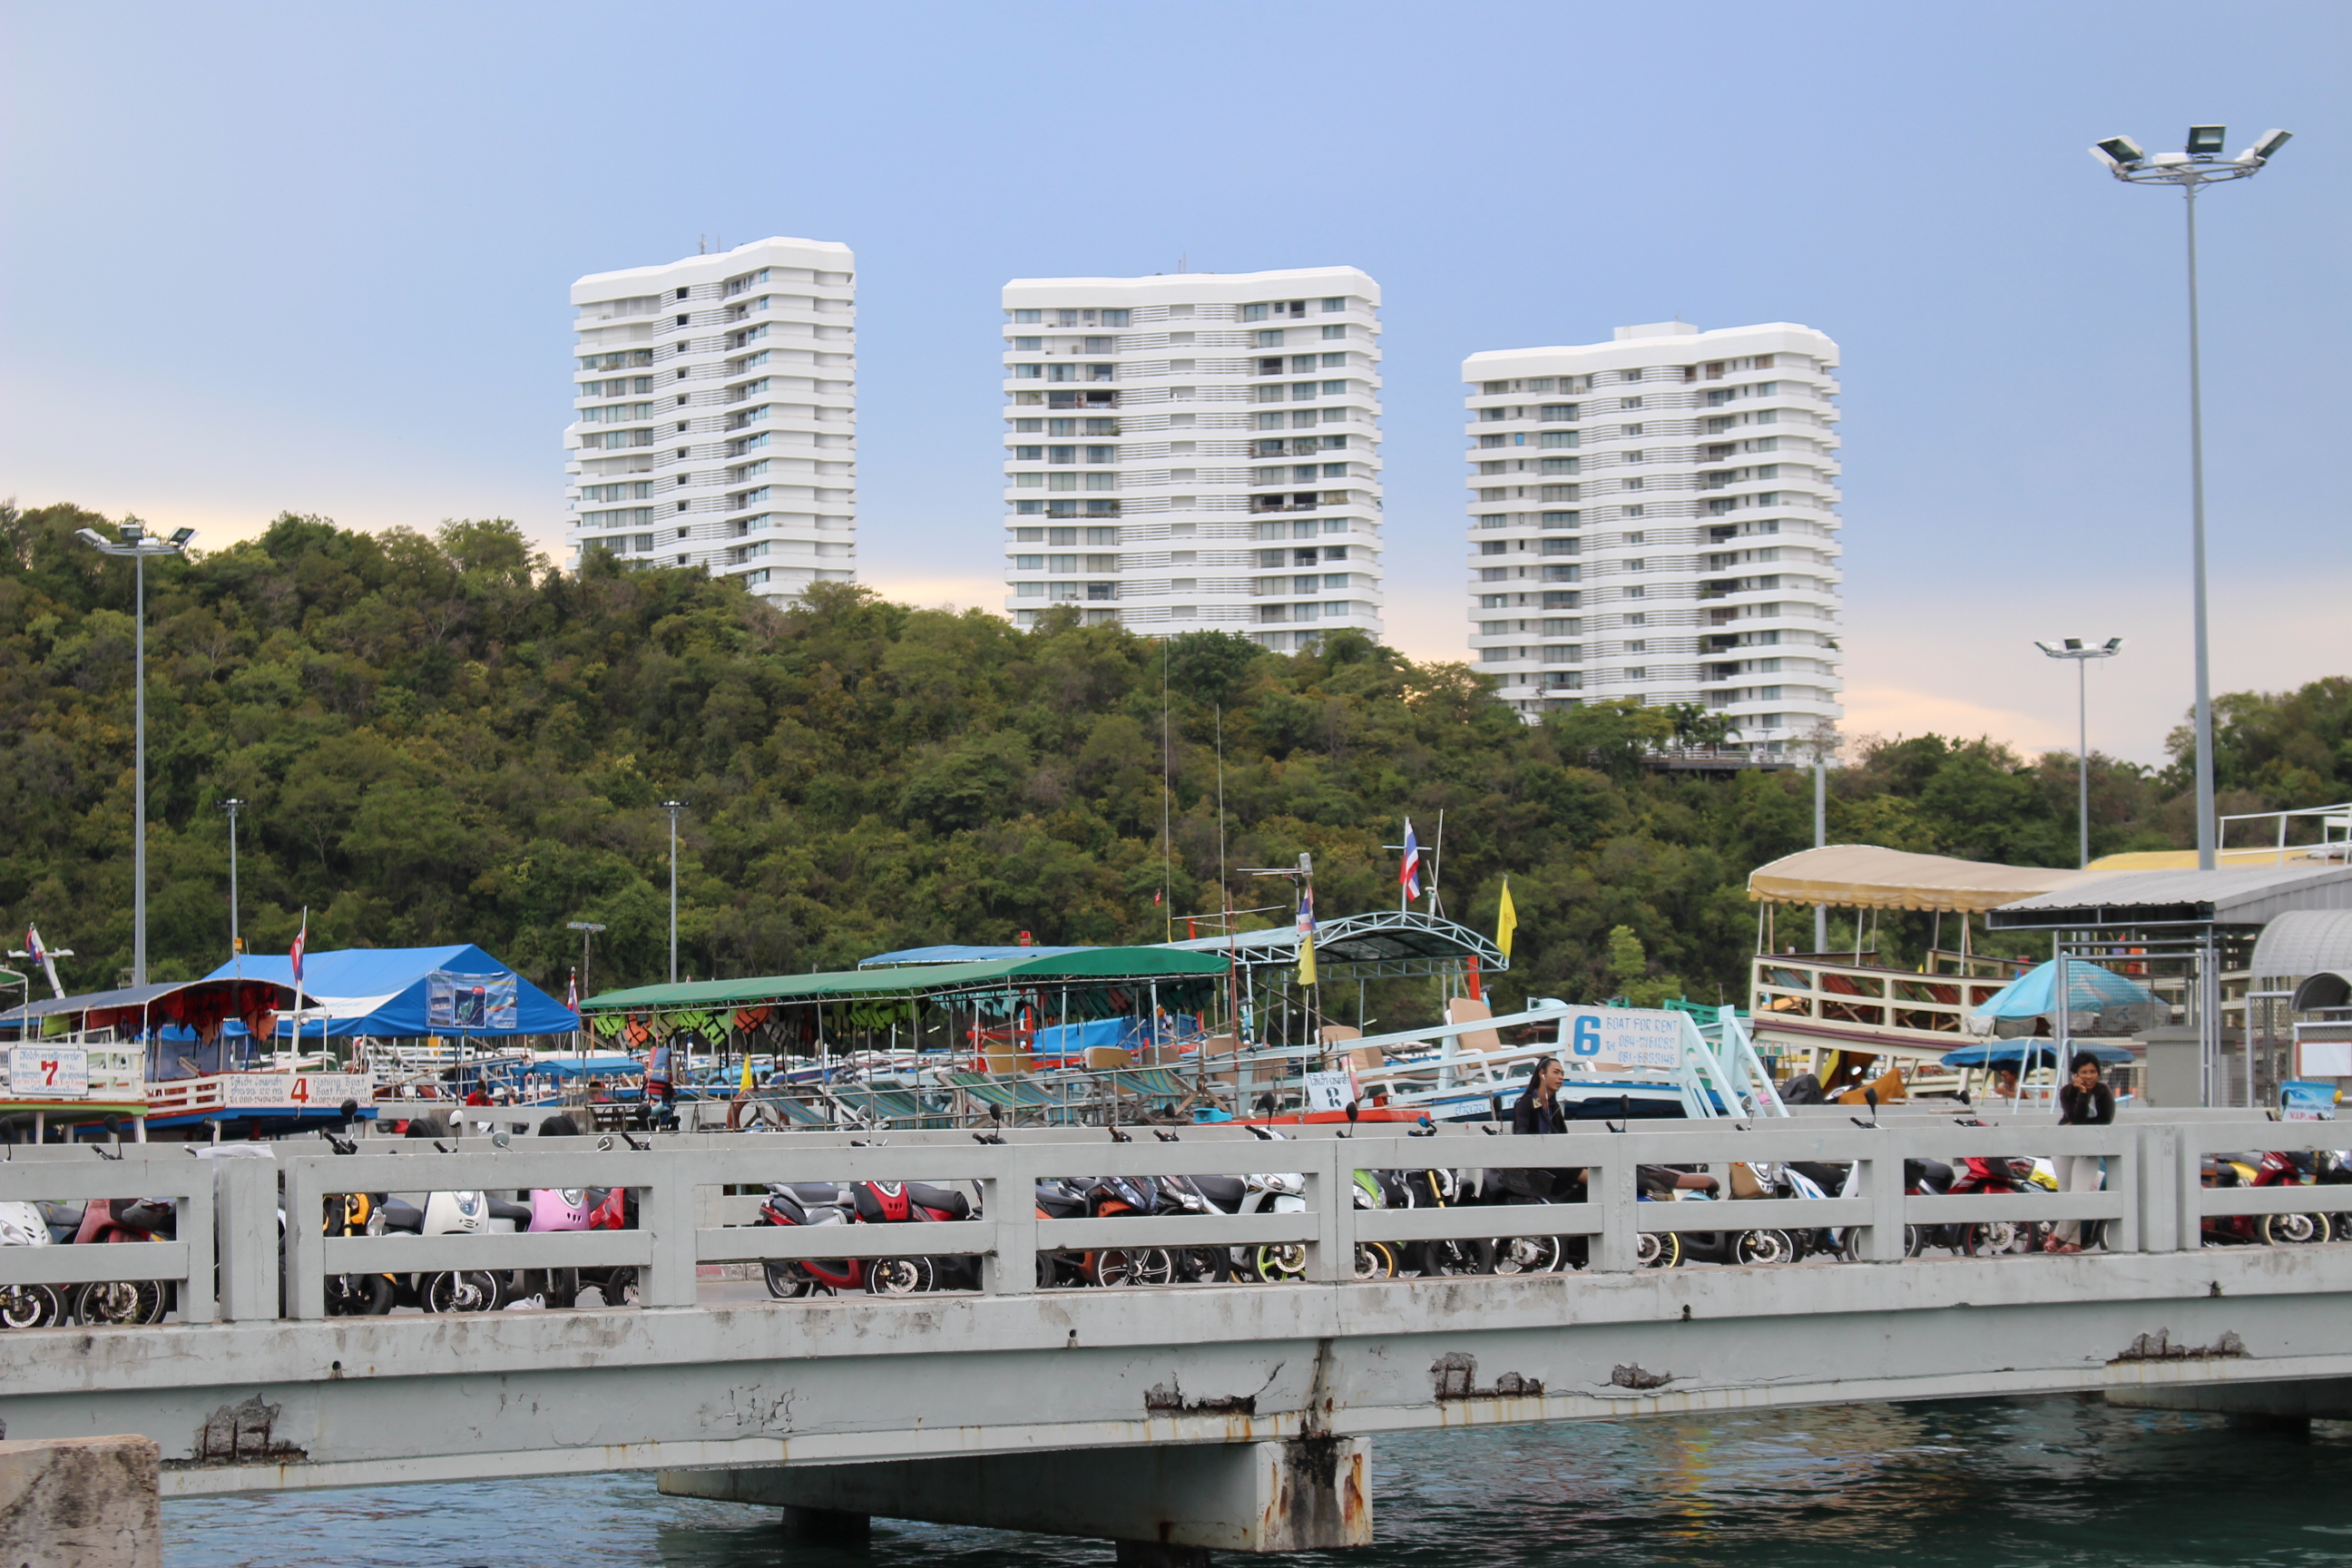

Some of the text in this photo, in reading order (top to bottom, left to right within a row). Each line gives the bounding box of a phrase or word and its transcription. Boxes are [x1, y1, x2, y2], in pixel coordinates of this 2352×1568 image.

[1573, 1015, 1602, 1056] 6
[1606, 1017, 1678, 1034] BOAT FOR RENT
[41, 1060, 59, 1086] 7
[313, 1076, 365, 1088] Fishing Boat
[290, 1078, 309, 1103] 4
[316, 1086, 333, 1095] Boat
[350, 1086, 368, 1095] Rent
